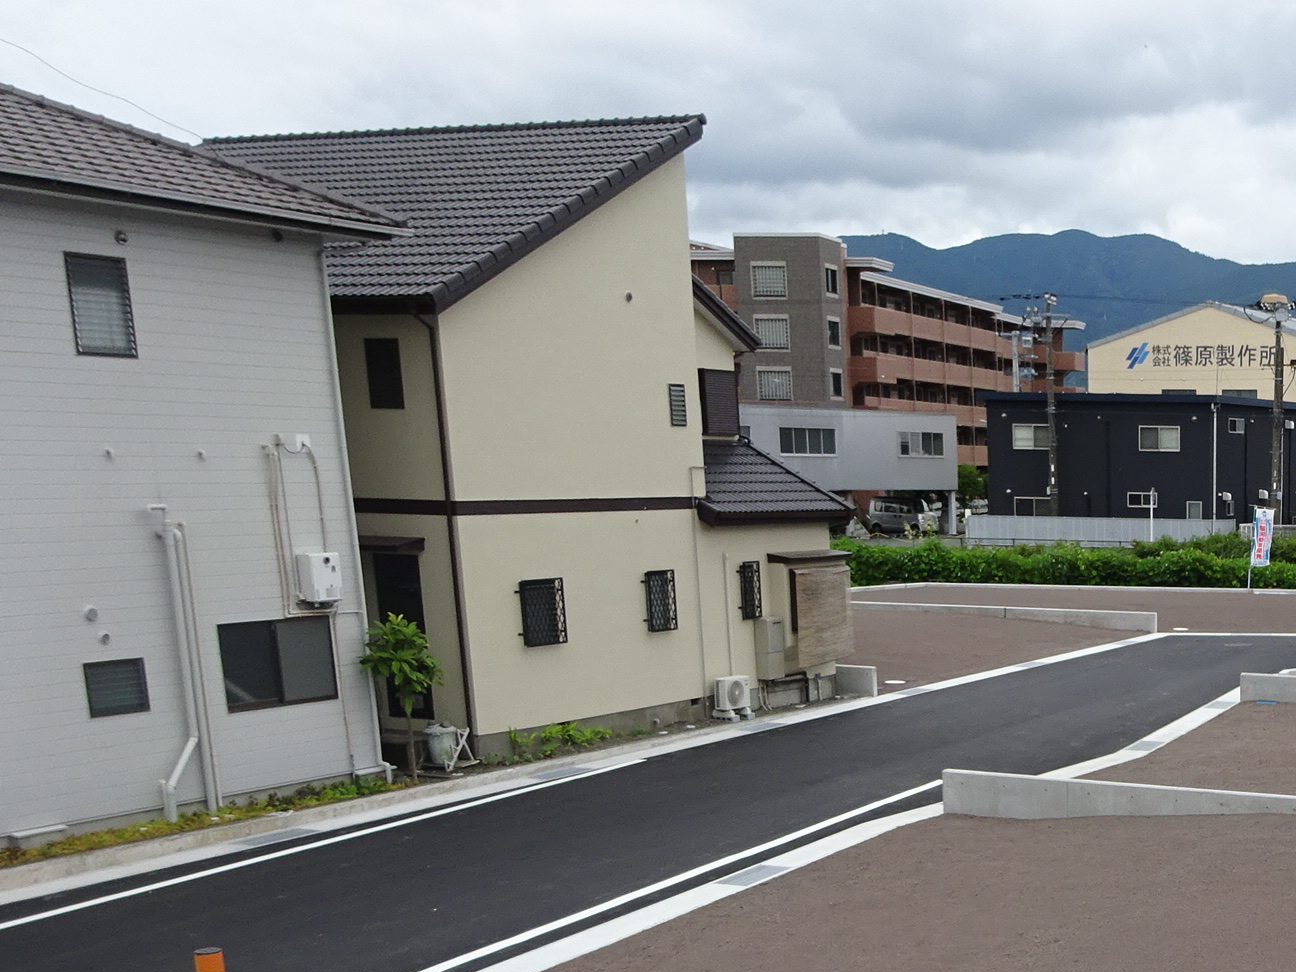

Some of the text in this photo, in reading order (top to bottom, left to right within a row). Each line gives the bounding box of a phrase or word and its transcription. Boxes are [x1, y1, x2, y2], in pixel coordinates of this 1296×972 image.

[1173, 344, 1277, 367] 篠原製作所
